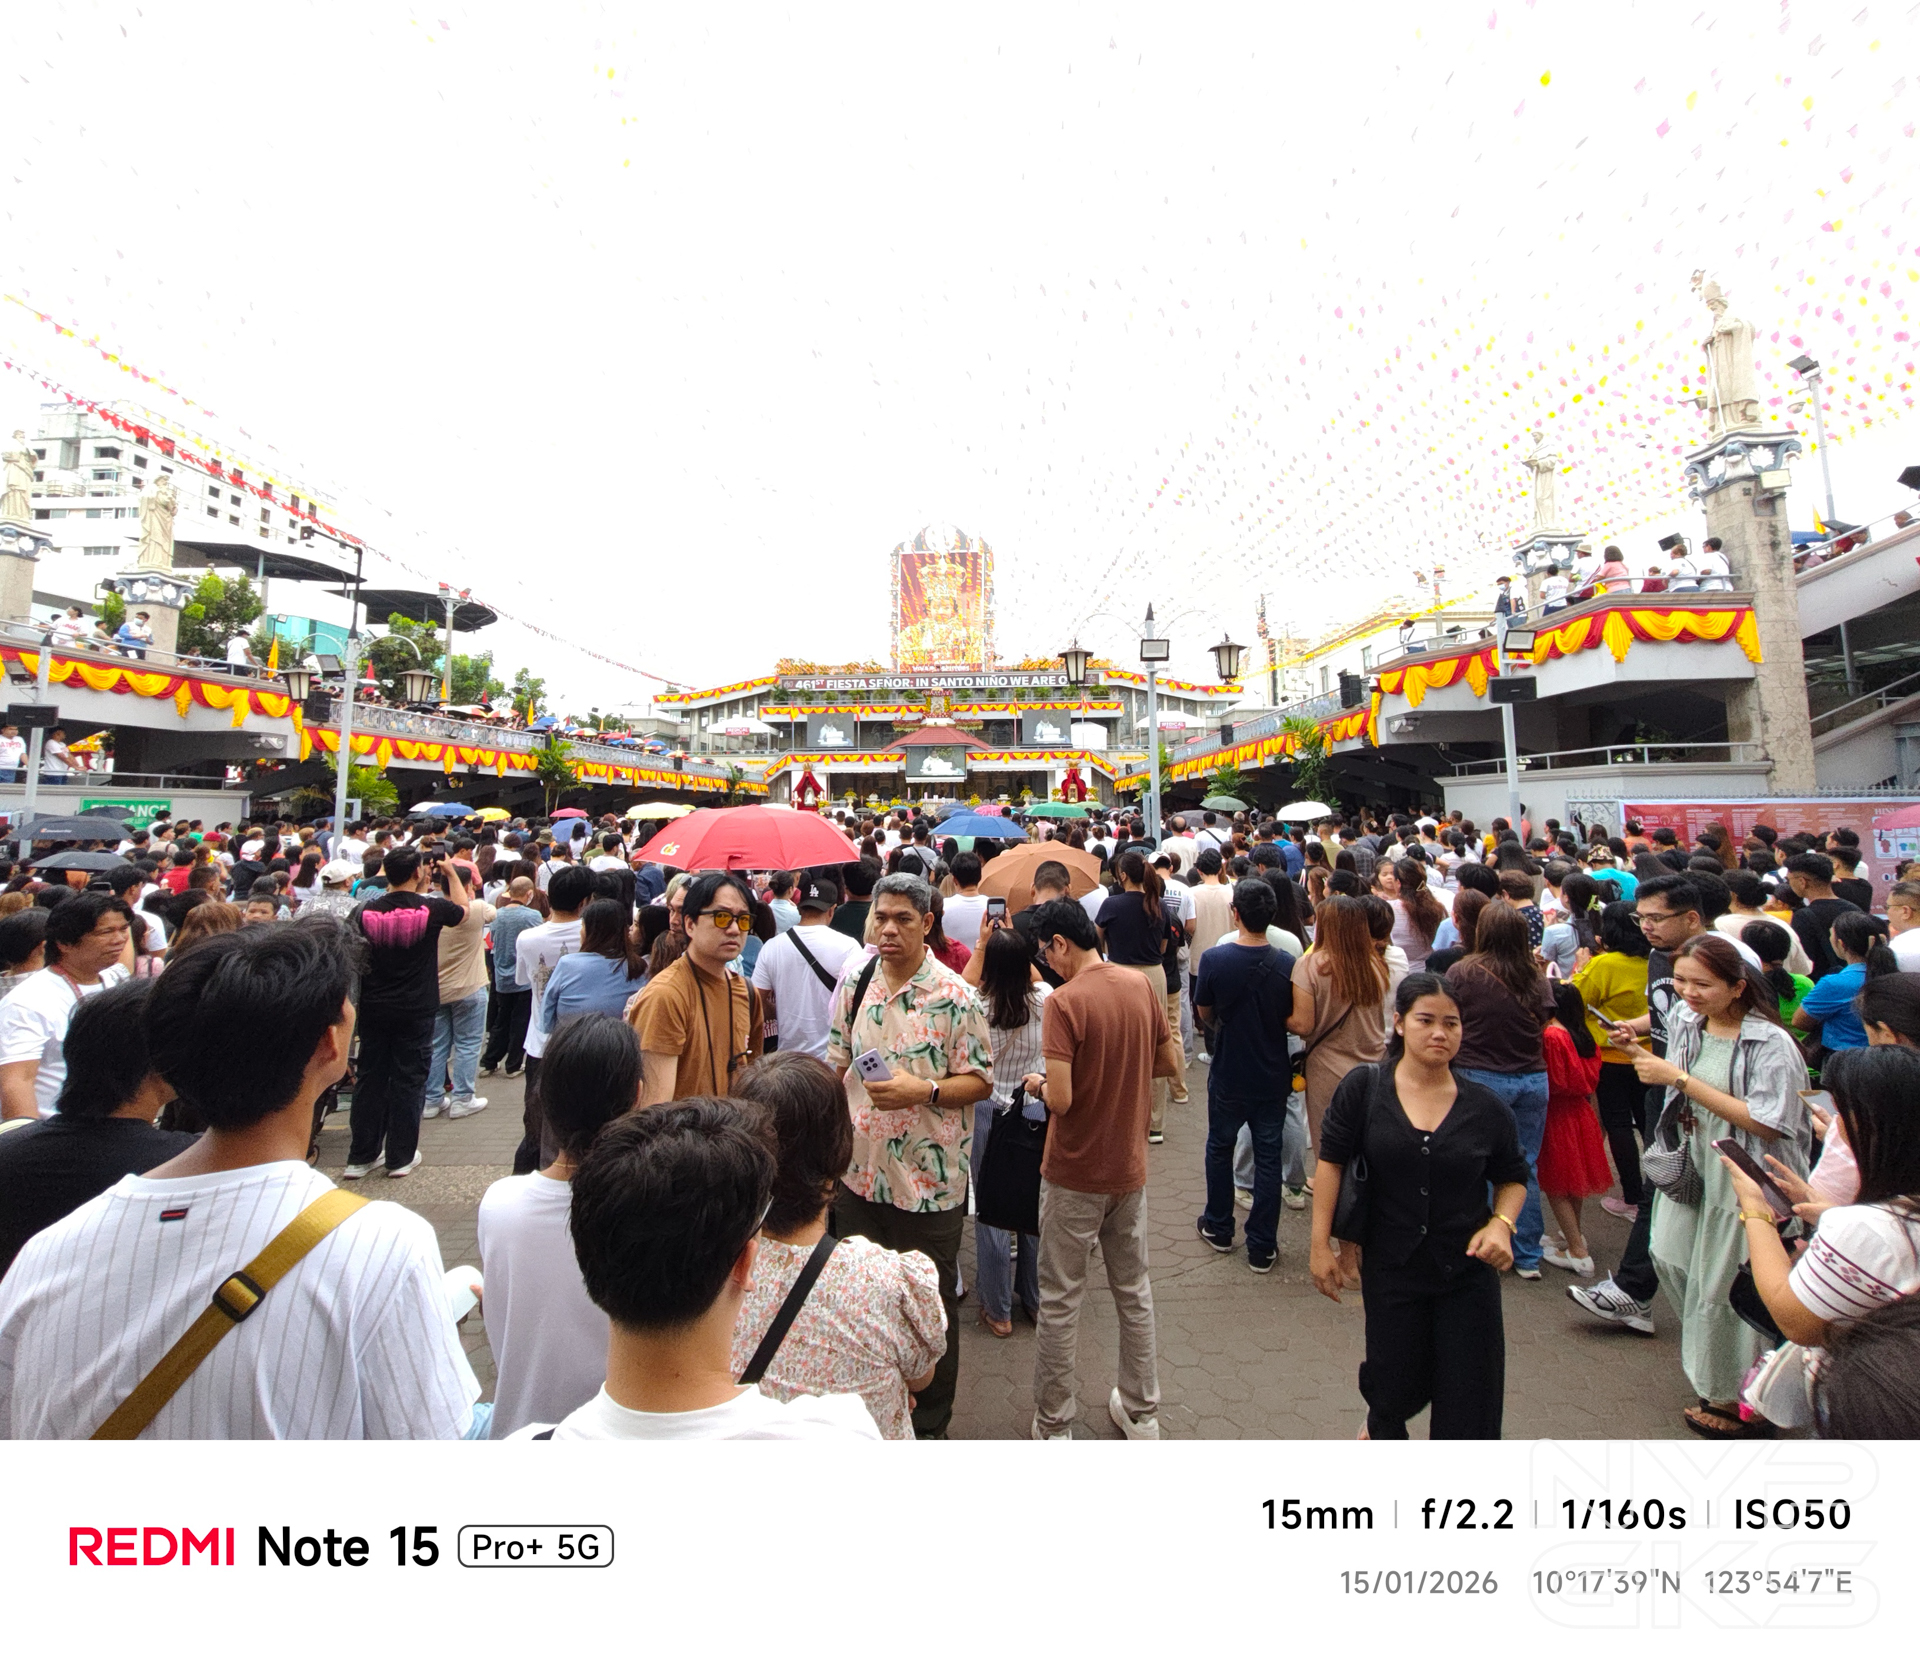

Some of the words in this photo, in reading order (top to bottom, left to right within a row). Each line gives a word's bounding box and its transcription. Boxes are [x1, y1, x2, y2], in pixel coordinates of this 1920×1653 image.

[827, 679, 867, 688] FIESTA
[868, 676, 914, 688] SEÑOR:
[916, 678, 929, 687] IN
[931, 677, 973, 687] SANTO
[976, 675, 1008, 686] NIÑO
[1009, 676, 1029, 686] WE
[1031, 676, 1056, 685] ARE
